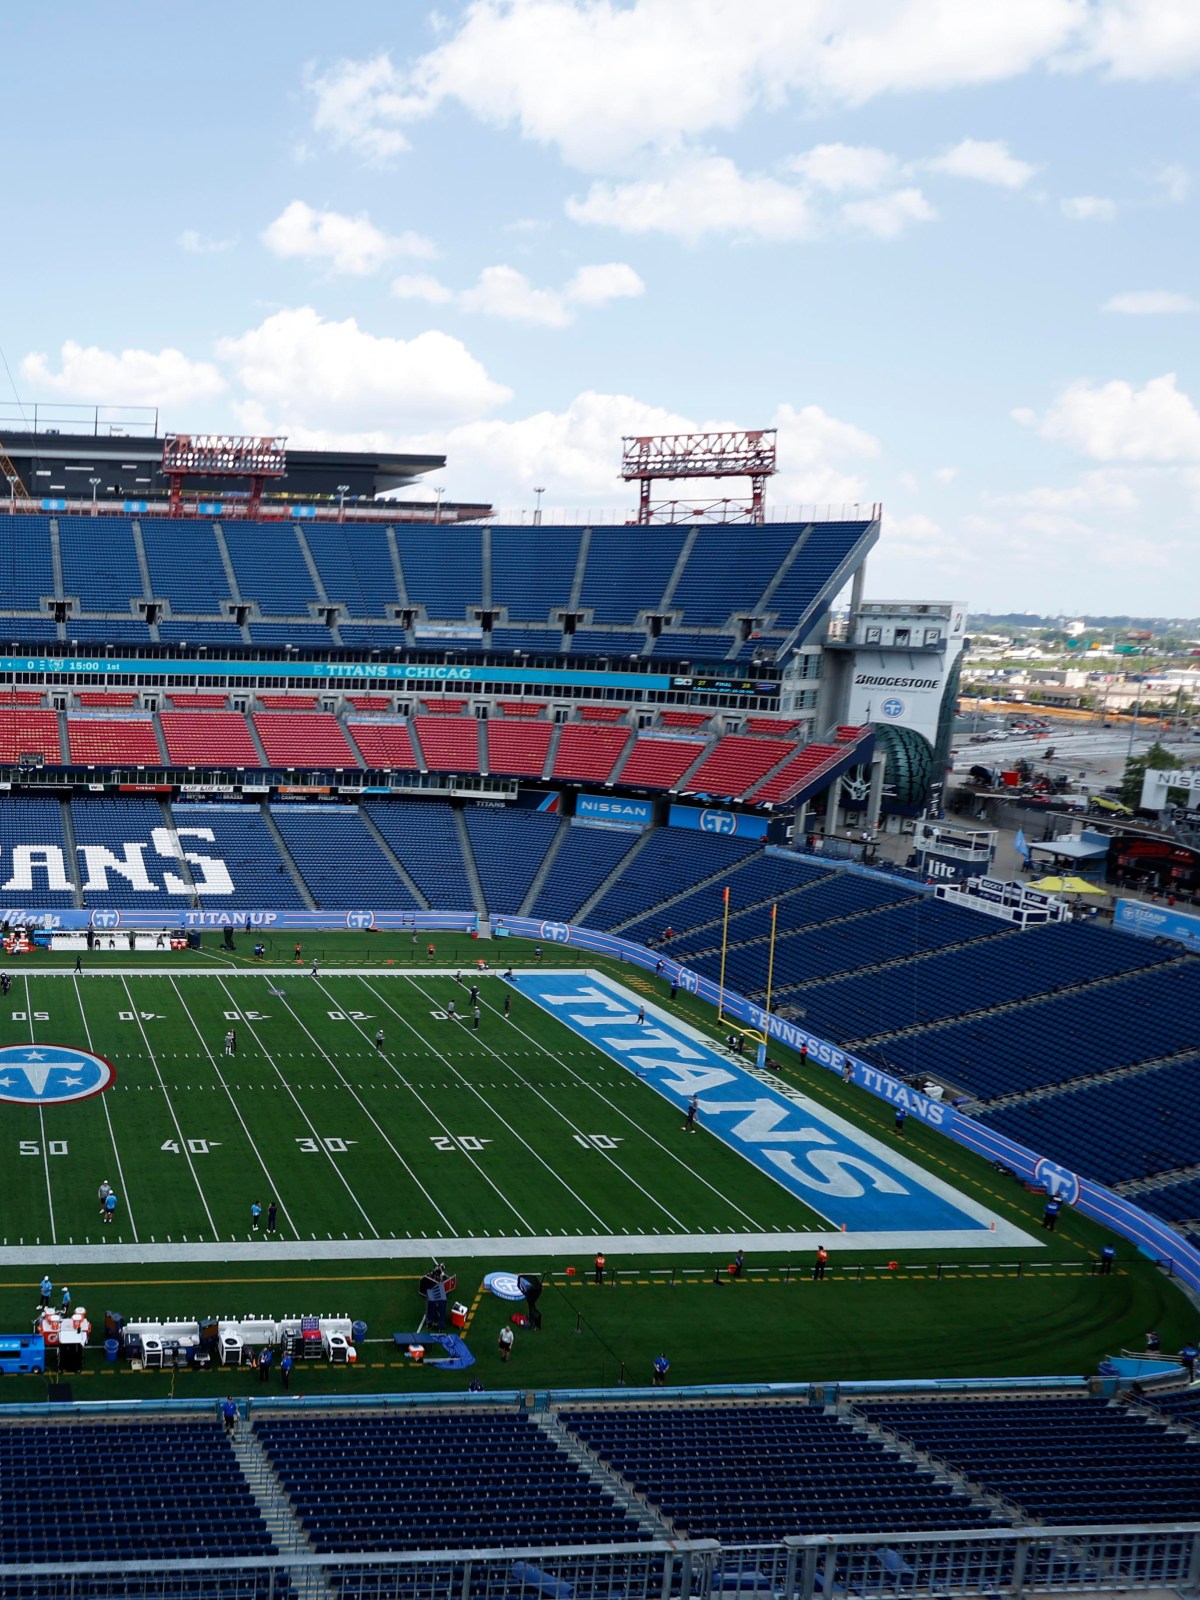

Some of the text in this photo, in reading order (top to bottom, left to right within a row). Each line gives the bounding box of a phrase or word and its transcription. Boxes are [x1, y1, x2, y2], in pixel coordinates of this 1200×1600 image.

[27, 661, 34, 669] 0
[69, 662, 99, 670] 15:00
[326, 665, 388, 677] TITANS
[854, 674, 940, 689] BRIDGESTONE
[476, 800, 506, 808] TITANS
[581, 801, 646, 816] NISSAN
[927, 860, 956, 878] Lite
[186, 912, 278, 925] TITAN UP
[540, 986, 910, 1198] TITANS
[861, 1068, 946, 1126] TITANS
[19, 1140, 68, 1156] 50
[160, 1139, 210, 1154] 40
[295, 1138, 349, 1153] 30
[430, 1136, 485, 1152] 20
[572, 1134, 618, 1149] 10
